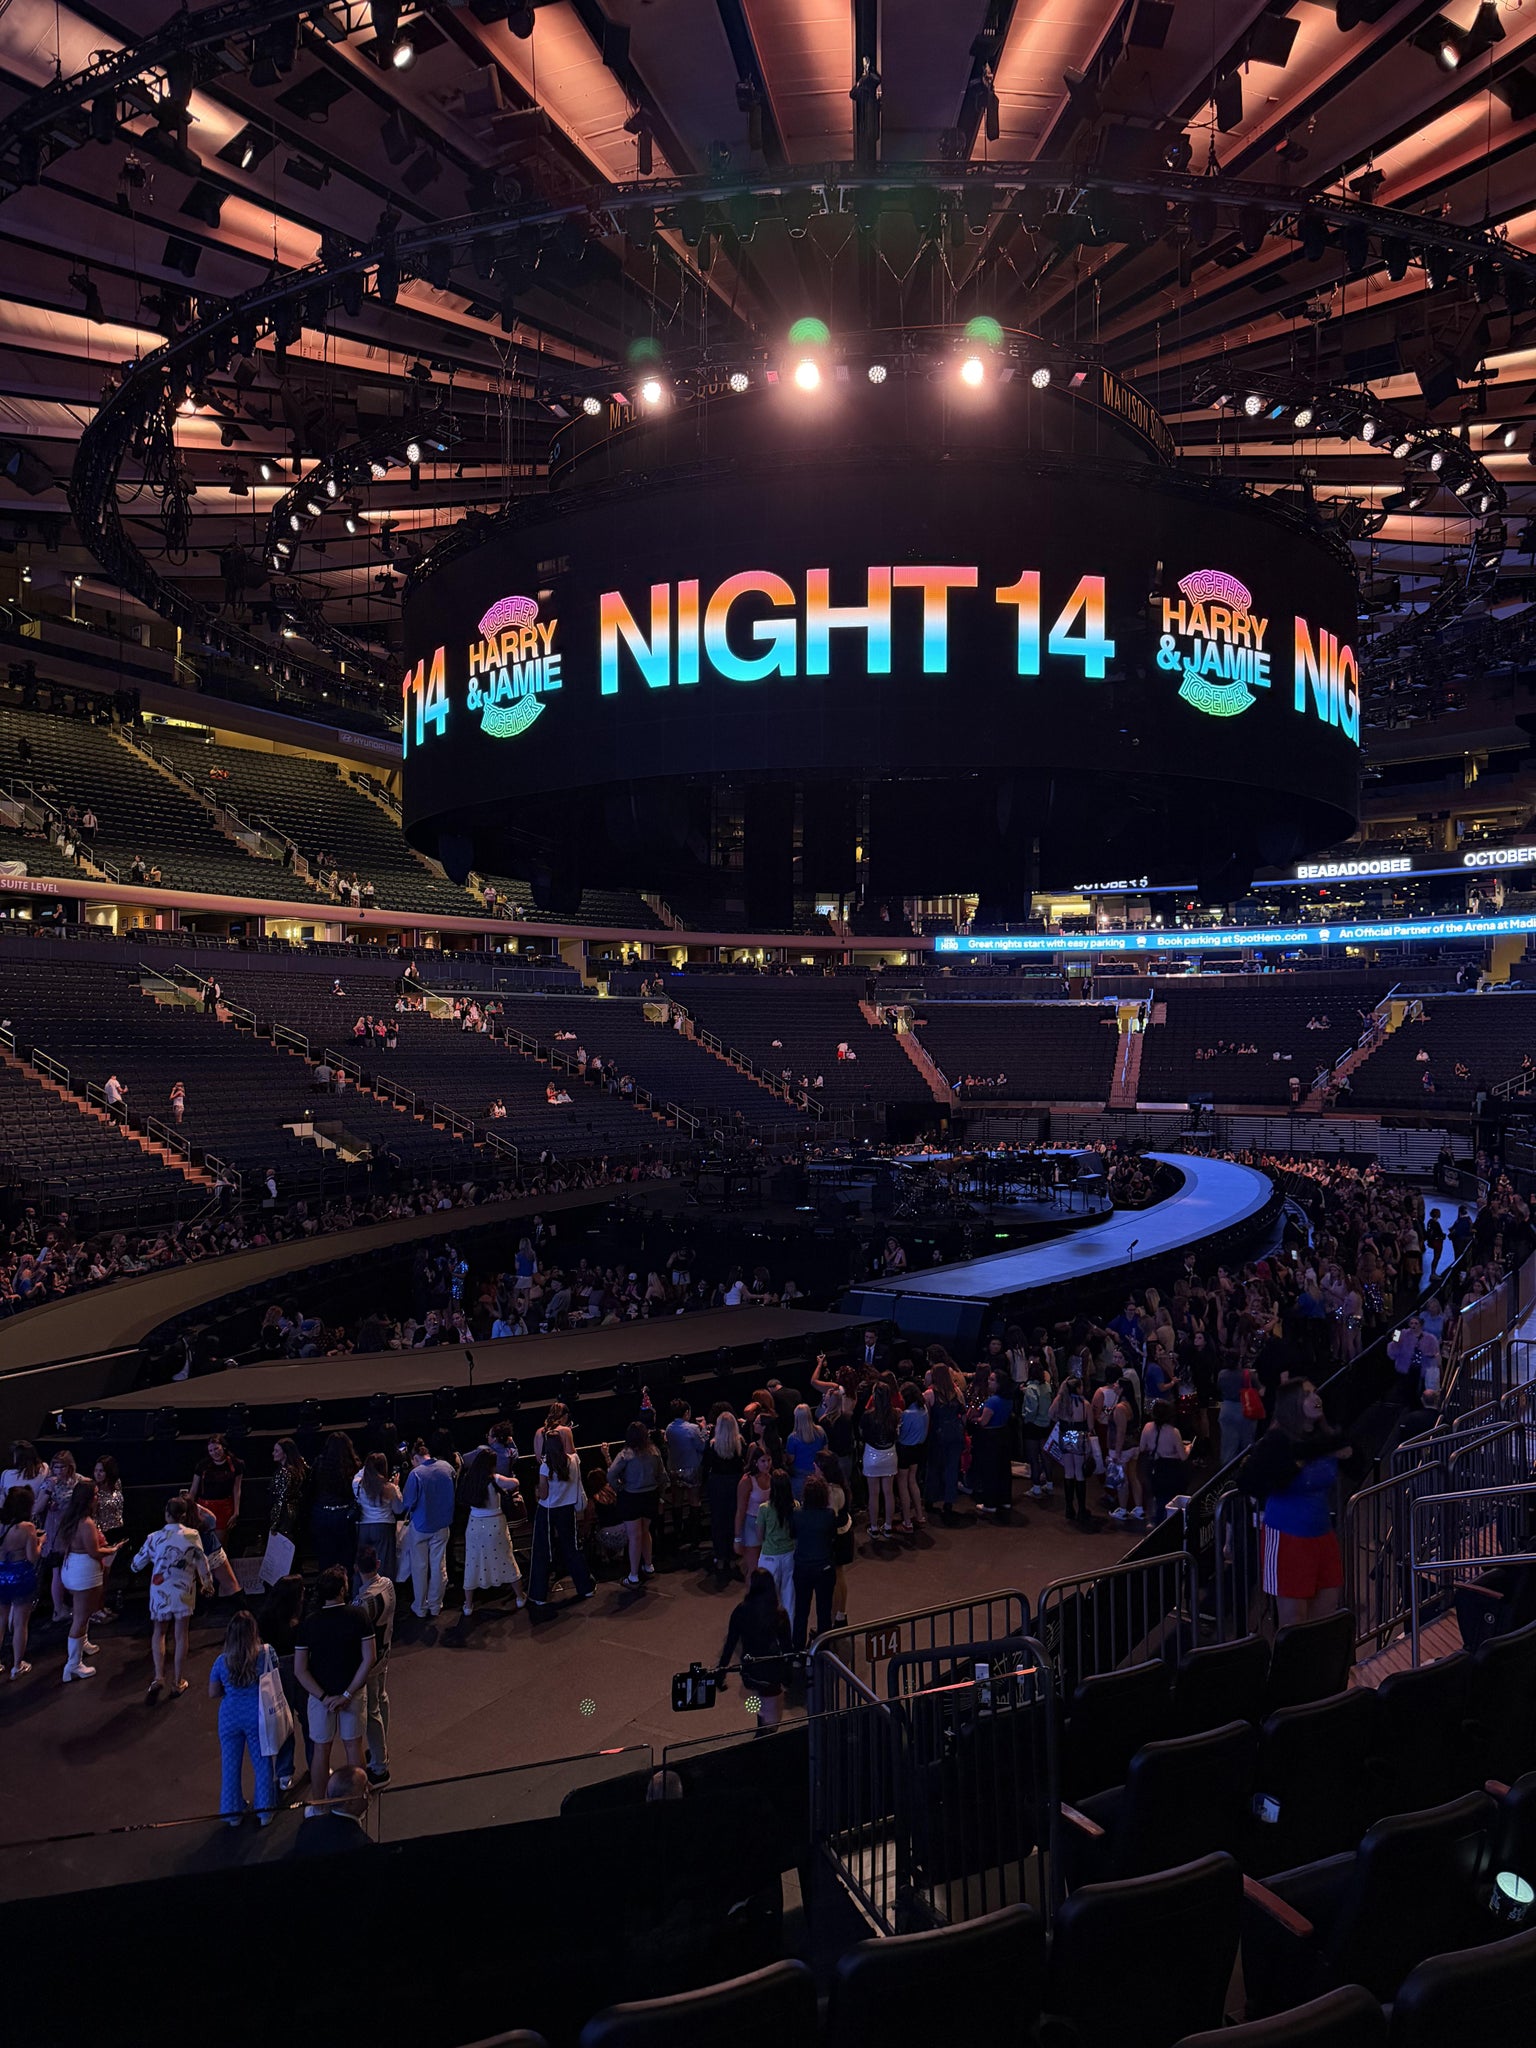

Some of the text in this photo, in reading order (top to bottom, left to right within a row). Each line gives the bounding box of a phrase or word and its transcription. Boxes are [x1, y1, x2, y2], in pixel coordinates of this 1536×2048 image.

[1103, 371, 1149, 433] MADISON
[1178, 569, 1253, 620] TOGETHER
[478, 595, 539, 641] TOGETHER
[600, 565, 1116, 695] NIGHT 14
[1162, 597, 1268, 651] HARRY
[469, 619, 558, 677] HARRY
[412, 645, 450, 746] 14
[480, 693, 546, 738] TOGETHER
[1178, 669, 1257, 717] TOGETHER
[353, 737, 386, 750] HYUNDAI
[1, 879, 59, 893] SUITE LEVEL
[1297, 859, 1411, 878] BEABADOOBEE
[968, 937, 1125, 950] Great nights start with easy parking
[1157, 931, 1308, 947] Book parking at SpotHero.com
[1339, 929, 1354, 939] An
[1354, 926, 1393, 938] Official
[1394, 925, 1431, 937] Partner
[1432, 923, 1444, 933] of
[1446, 922, 1463, 933] the
[1464, 920, 1496, 931] Arena
[1497, 920, 1508, 930] at
[870, 1631, 898, 1658] 114
